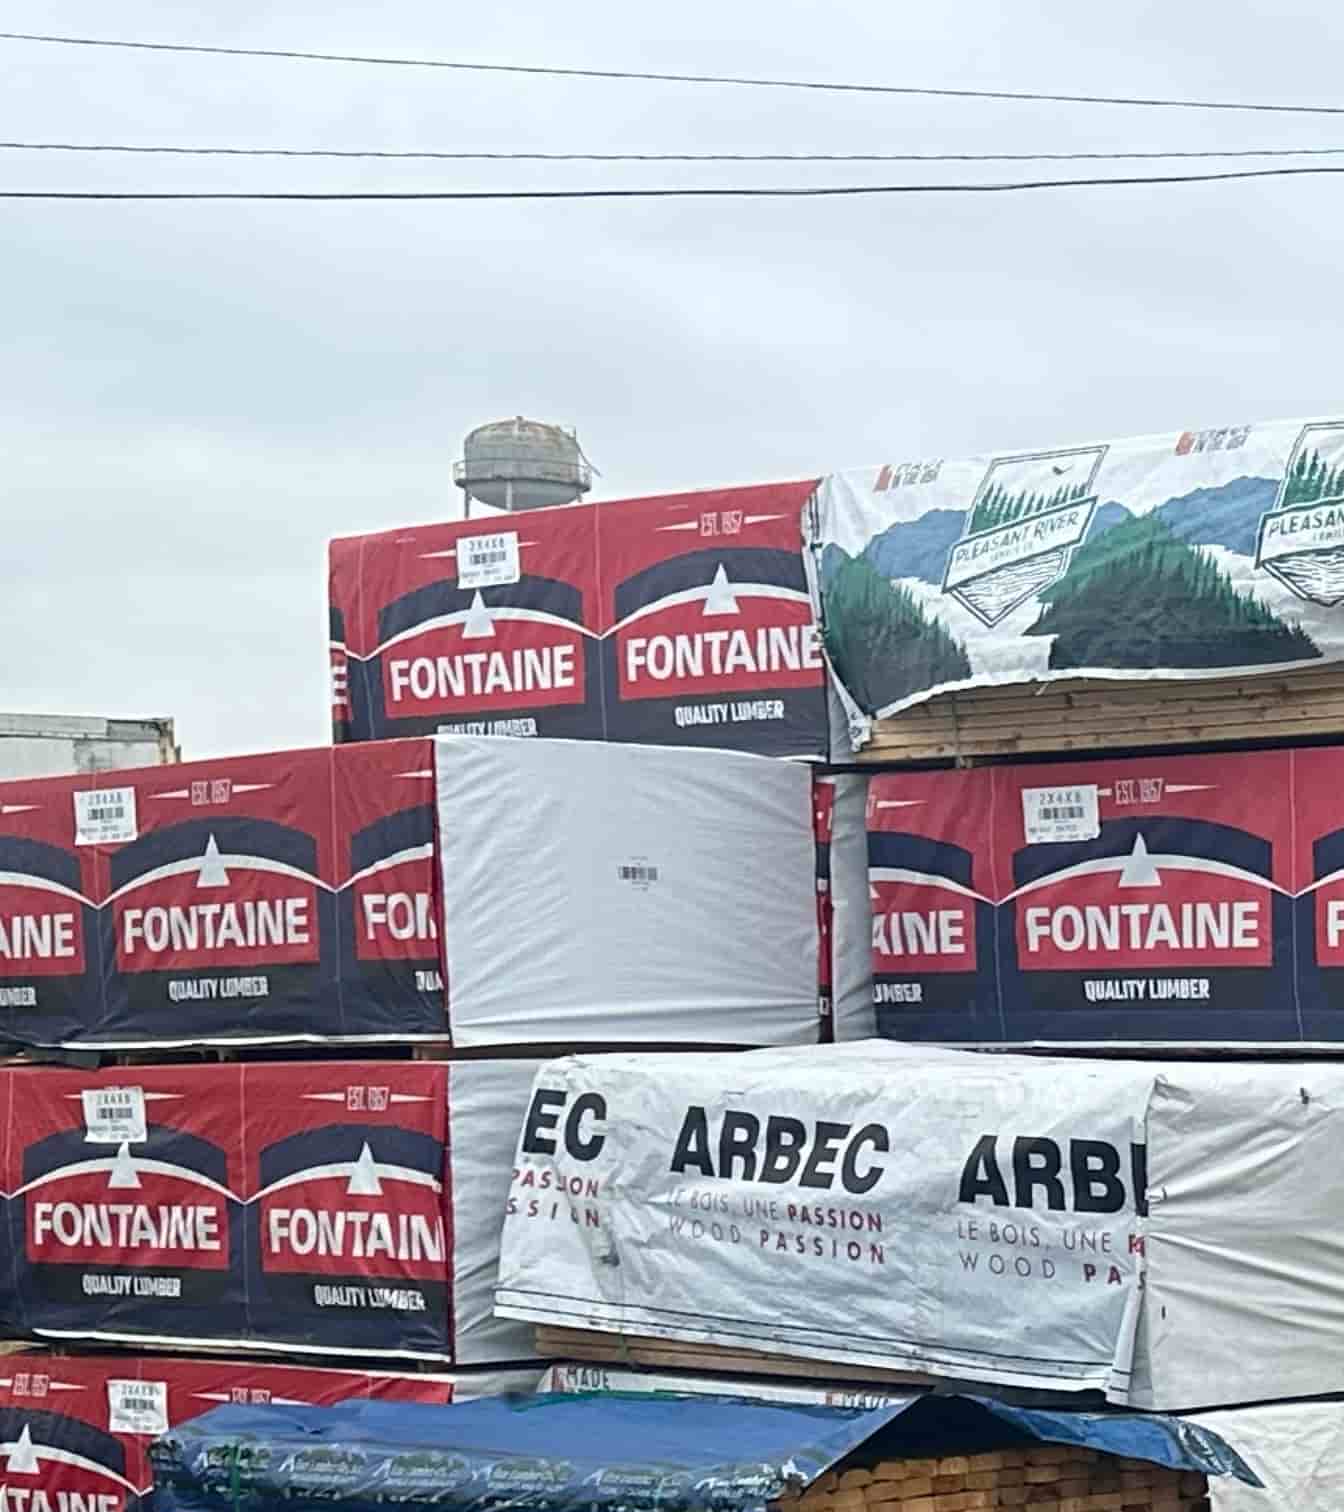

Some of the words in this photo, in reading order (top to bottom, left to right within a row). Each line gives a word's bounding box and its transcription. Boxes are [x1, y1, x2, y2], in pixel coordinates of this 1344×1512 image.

[956, 526, 1030, 562] PLEASANT
[1033, 511, 1080, 540] RIVER
[390, 645, 576, 701] FONTAINE
[627, 624, 824, 683] FONTAINE
[675, 703, 728, 728] QUALITY
[123, 898, 310, 955] FONTAINE
[1025, 900, 1262, 954] FONTAINE
[168, 977, 218, 1001] QUALITY
[1084, 980, 1148, 1002] QUALITY
[1149, 979, 1210, 1000] LUMBER
[669, 1105, 890, 1194] ARBEC
[34, 1200, 221, 1251] FONTAINE
[670, 1215, 742, 1244] WOOD
[759, 1229, 886, 1265] PASSION
[743, 1201, 780, 1221] UNE
[787, 1203, 883, 1233] PASSION
[957, 1220, 978, 1241] LE
[1063, 1229, 1112, 1253] UNE
[959, 1251, 1056, 1279] WOOD
